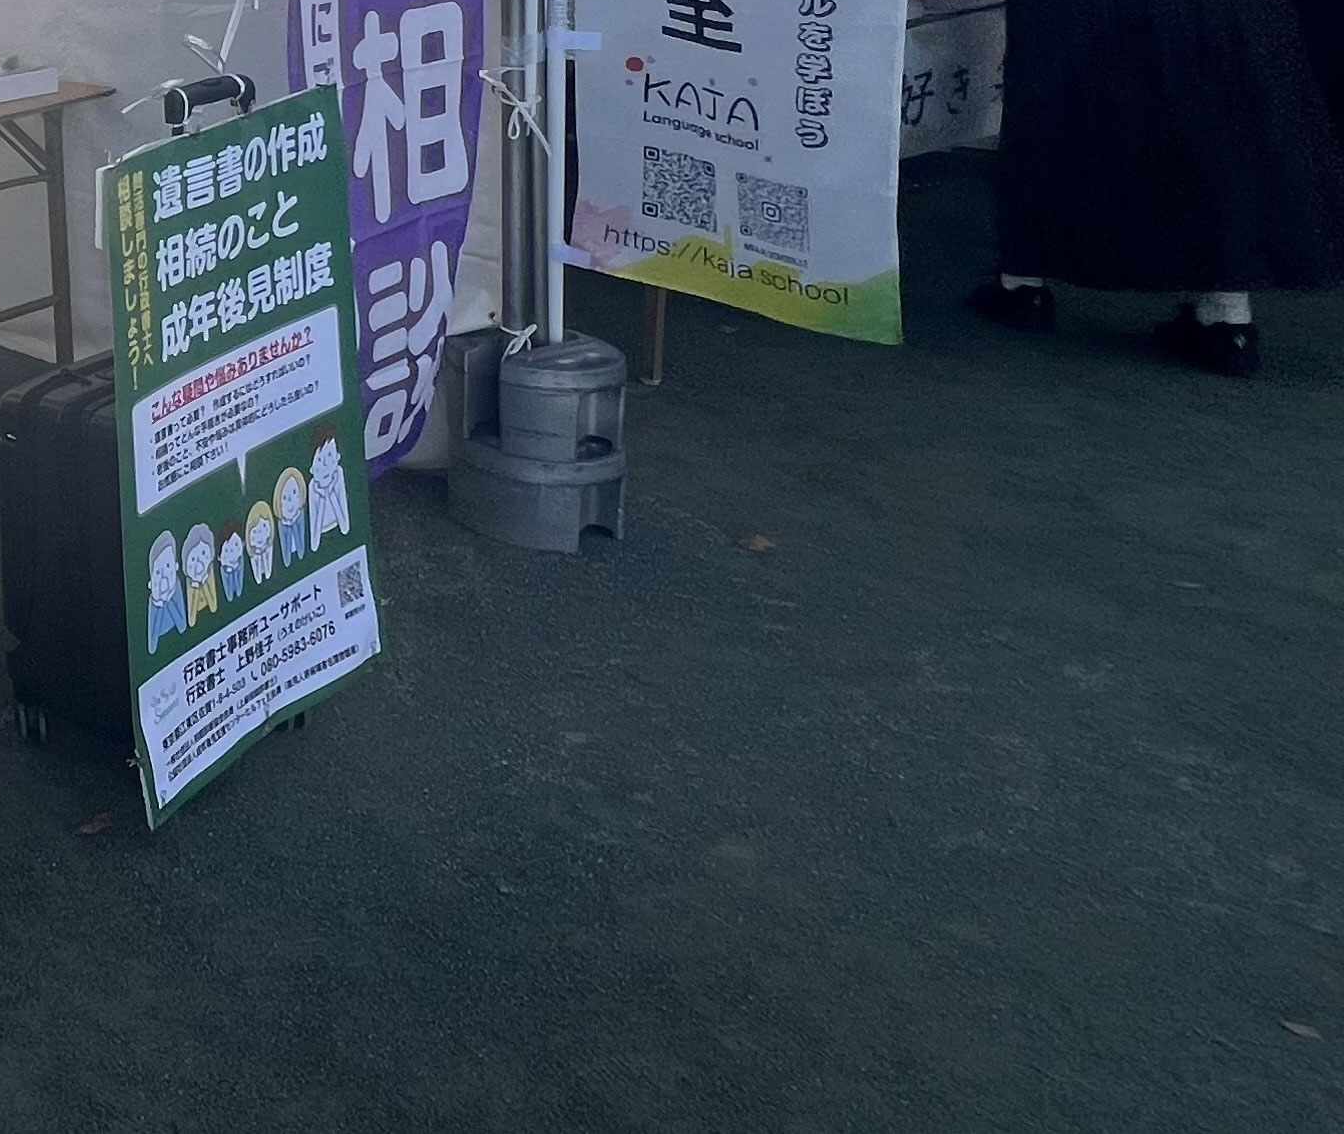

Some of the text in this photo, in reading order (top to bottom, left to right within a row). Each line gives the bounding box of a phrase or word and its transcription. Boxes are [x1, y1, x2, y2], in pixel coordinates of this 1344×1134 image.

[643, 73, 759, 132] KAJA
[643, 111, 711, 139] Language
[153, 112, 327, 223] 遺言書の作成
[156, 191, 299, 291] 相続のこと
[161, 241, 334, 362] 成年後見制度
